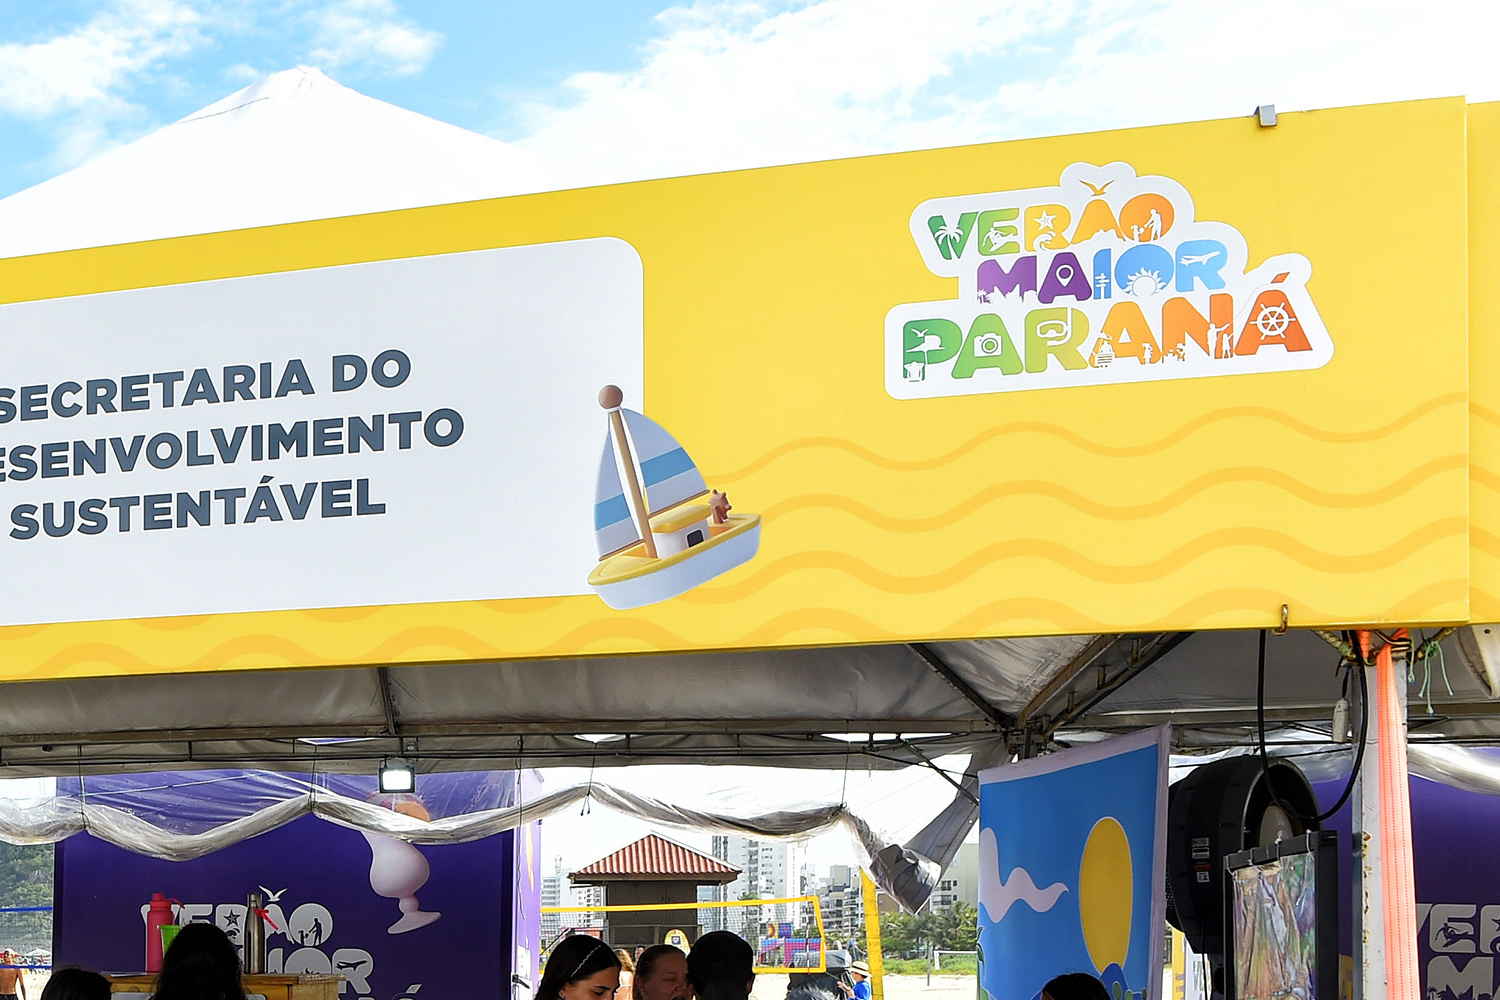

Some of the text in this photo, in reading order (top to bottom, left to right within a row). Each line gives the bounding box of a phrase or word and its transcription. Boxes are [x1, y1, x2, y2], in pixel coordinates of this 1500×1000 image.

[927, 178, 1175, 261] VERÃO
[976, 238, 1228, 304] MAIOR
[902, 271, 1314, 383] PARANÁ
[330, 348, 414, 395] DO
[8, 474, 388, 540] SUSTENTÁVEL
